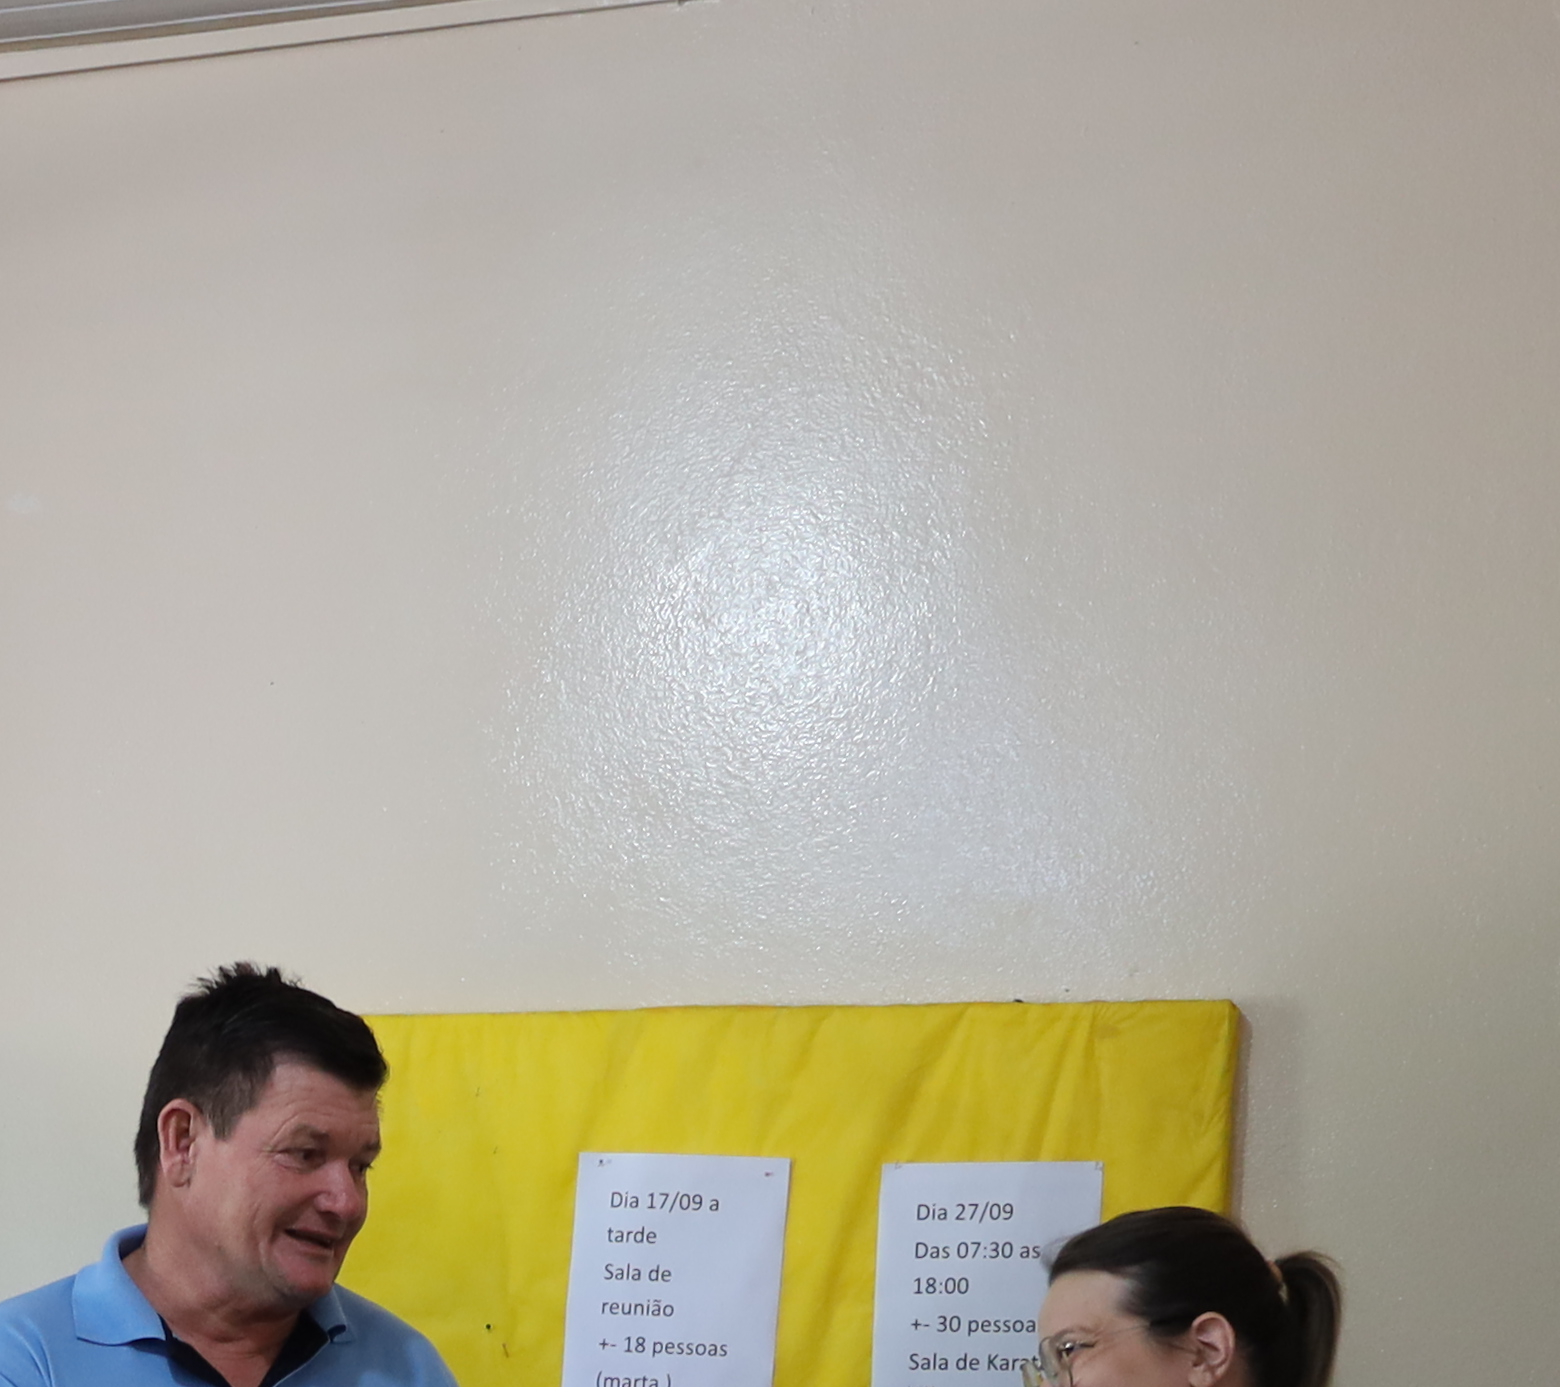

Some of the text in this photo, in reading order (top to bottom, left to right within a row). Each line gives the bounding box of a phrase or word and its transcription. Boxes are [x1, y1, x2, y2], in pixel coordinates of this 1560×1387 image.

[610, 1191, 720, 1214] Dia 17/09 a
[915, 1201, 1015, 1225] Dia 27/09
[607, 1225, 658, 1245] tarde
[913, 1240, 1041, 1261] Das 07:30 as
[603, 1262, 672, 1283] Sala de
[912, 1275, 971, 1296] 18:00
[601, 1298, 675, 1318] reunião
[910, 1315, 1037, 1337] +- 30 pessoa
[598, 1335, 729, 1358] +- 18 pessoas
[908, 1352, 949, 1372] Sala
[955, 1352, 981, 1372] de
